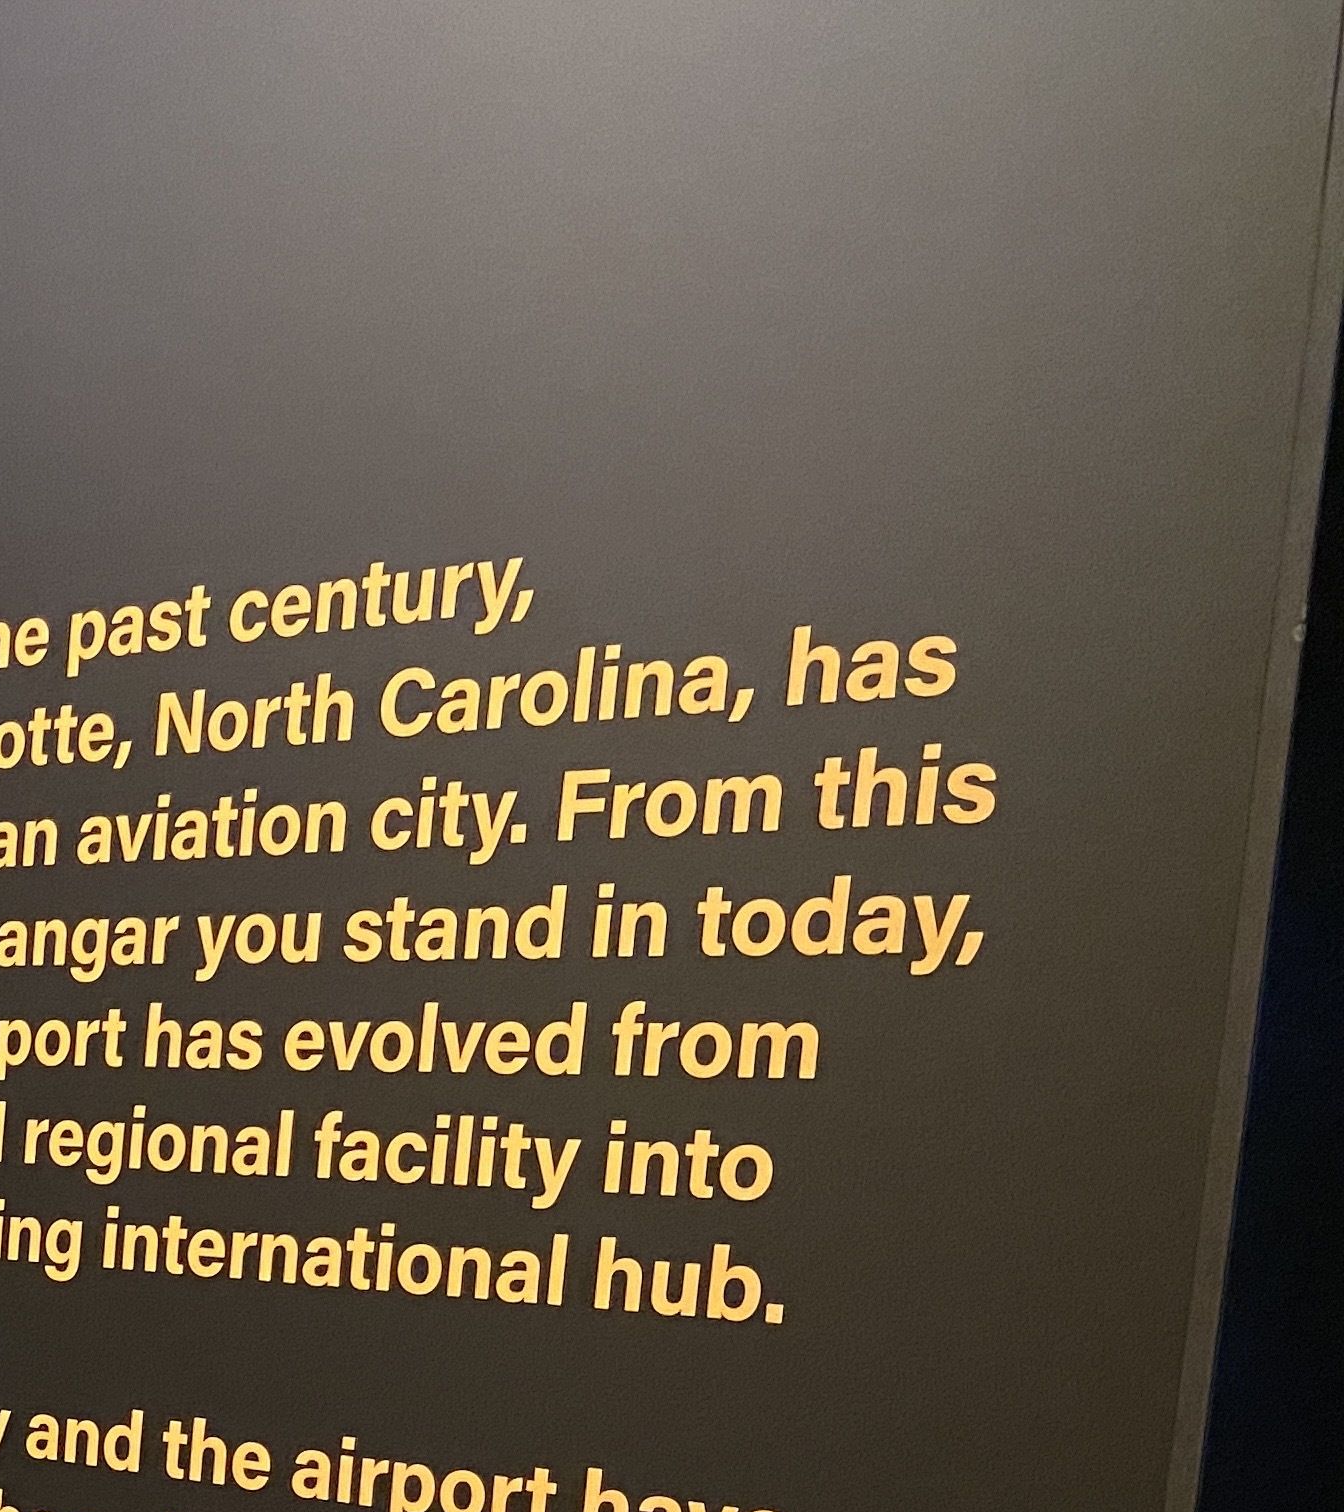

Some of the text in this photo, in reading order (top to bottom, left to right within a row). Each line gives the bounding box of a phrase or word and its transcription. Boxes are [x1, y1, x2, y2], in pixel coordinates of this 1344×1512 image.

[66, 584, 212, 678] past
[229, 556, 535, 643] century,
[155, 672, 354, 756] North
[380, 642, 755, 738] Carolina,
[786, 624, 958, 707] has
[76, 788, 347, 865] aviation
[370, 776, 527, 866] city.
[557, 768, 783, 842] From
[813, 742, 997, 830] this
[195, 912, 322, 982] you
[343, 884, 568, 963] stand
[592, 882, 668, 958] in
[696, 874, 984, 976] today,
[144, 1002, 263, 1071] has
[284, 1001, 588, 1076] evolved
[611, 1000, 819, 1080] from
[23, 1104, 295, 1185] regional
[314, 1110, 582, 1210] facility
[603, 1119, 774, 1201] into
[102, 1205, 570, 1306] international
[593, 1236, 785, 1325] hub.
[25, 1408, 144, 1473] and
[162, 1416, 271, 1491] the
